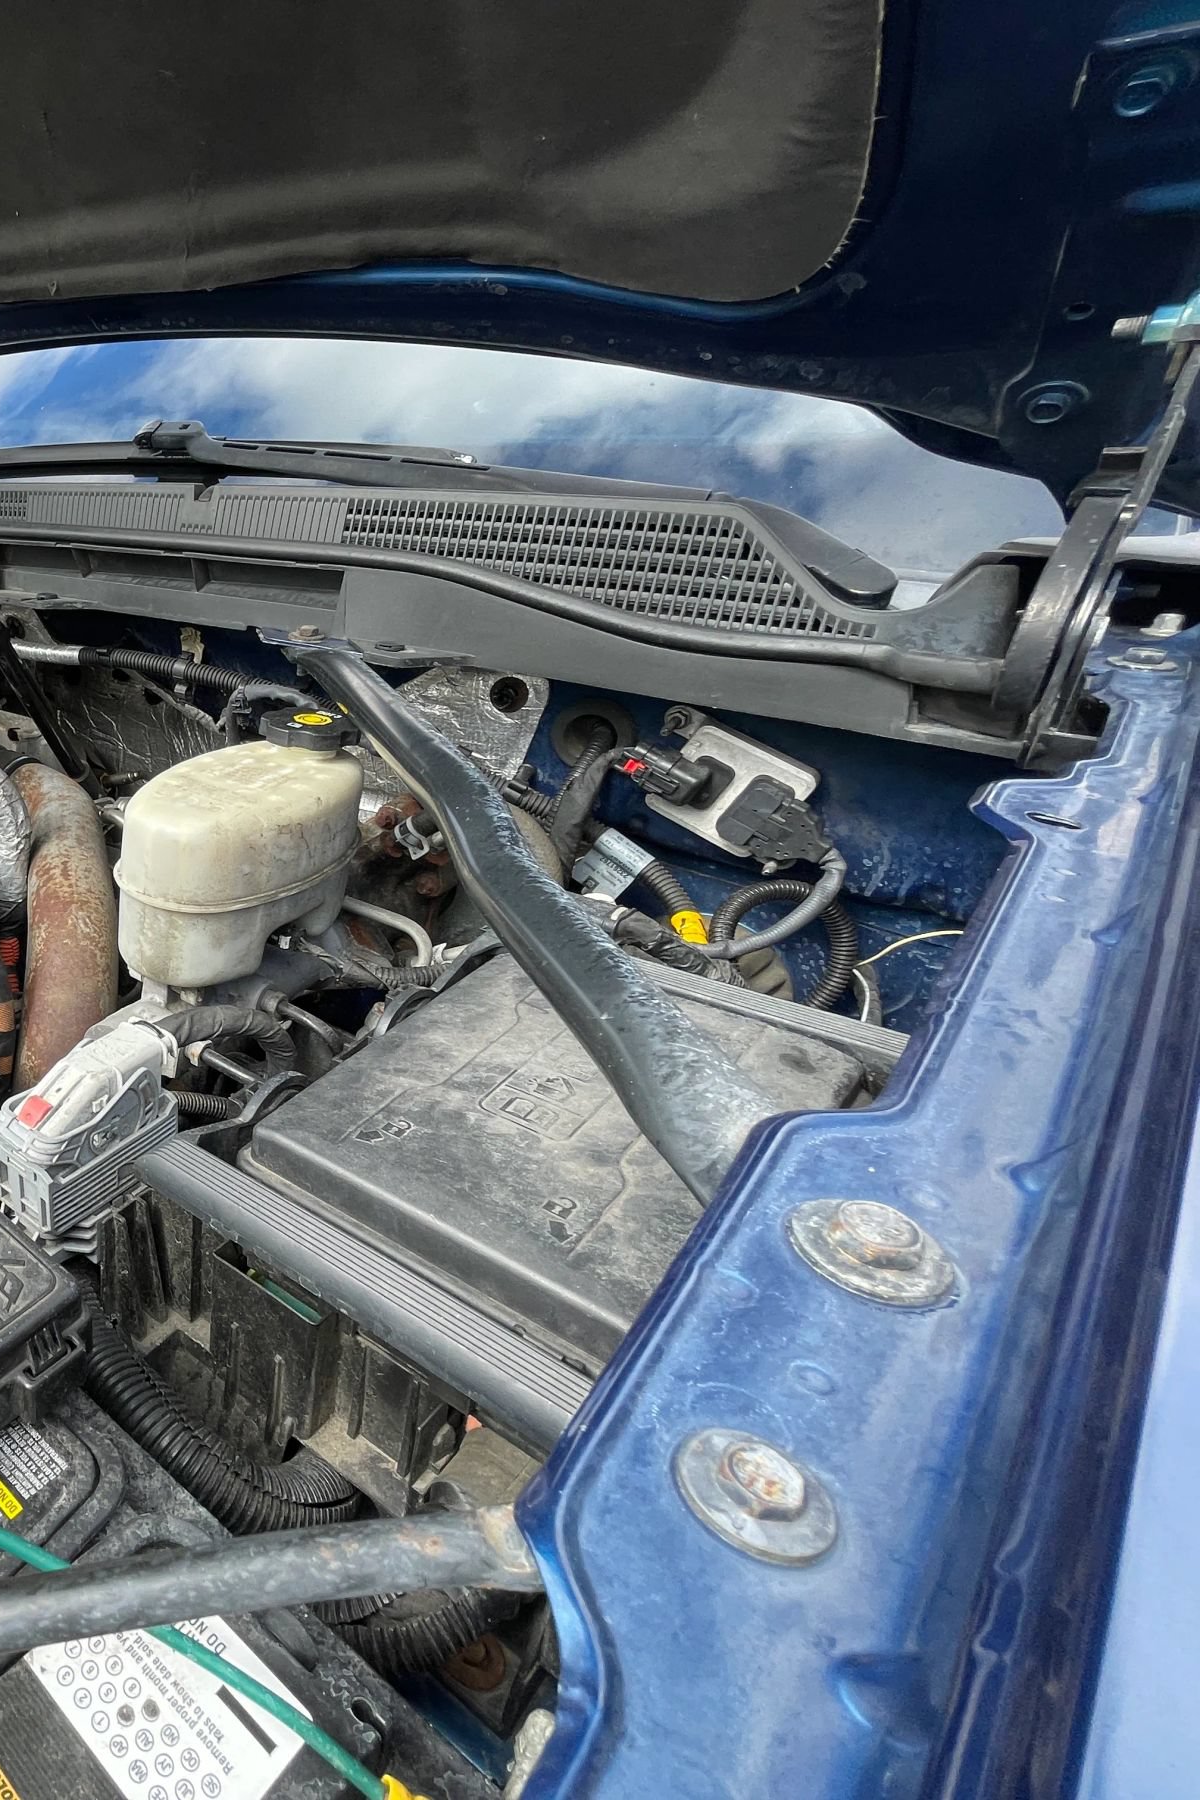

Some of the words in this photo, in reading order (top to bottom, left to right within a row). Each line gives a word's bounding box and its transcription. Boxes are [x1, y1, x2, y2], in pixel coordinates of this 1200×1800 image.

[4, 1499, 18, 1513] DO
[187, 1615, 209, 1635] NO
[113, 1630, 130, 1646] ye
[129, 1632, 154, 1659] sold.
[204, 1632, 227, 1655] DO
[123, 1644, 143, 1665] and
[138, 1662, 169, 1696] month
[149, 1656, 172, 1681] date
[168, 1678, 195, 1708] show
[166, 1693, 199, 1729] proper
[191, 1705, 205, 1720] to
[194, 1727, 235, 1776] Remove
